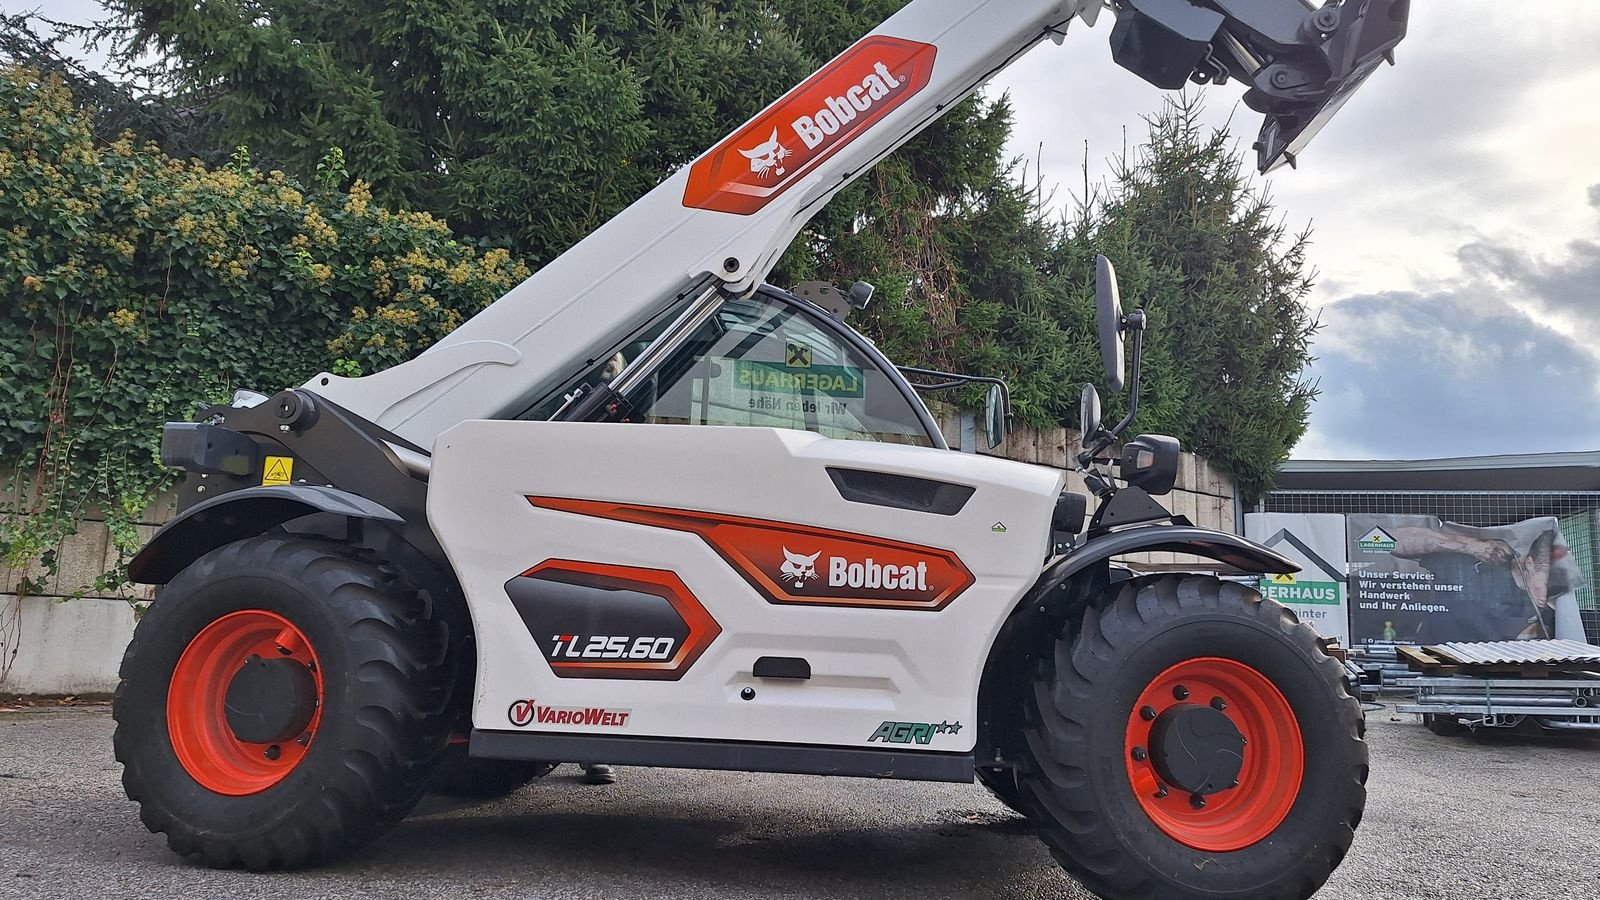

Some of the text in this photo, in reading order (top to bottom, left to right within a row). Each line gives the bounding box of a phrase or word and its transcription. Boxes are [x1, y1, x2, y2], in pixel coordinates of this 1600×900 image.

[791, 61, 900, 150] Bobcat
[828, 556, 927, 591] Bobcat
[1359, 570, 1435, 580] Unser Service:
[1260, 586, 1336, 600] GERHAUS
[1359, 580, 1464, 592] Wir verstehen unser
[1359, 591, 1410, 600] Handwerk
[1359, 601, 1449, 613] und Ihr Anliegen.
[551, 635, 675, 659] TL25.60
[867, 721, 937, 745] AGRI
